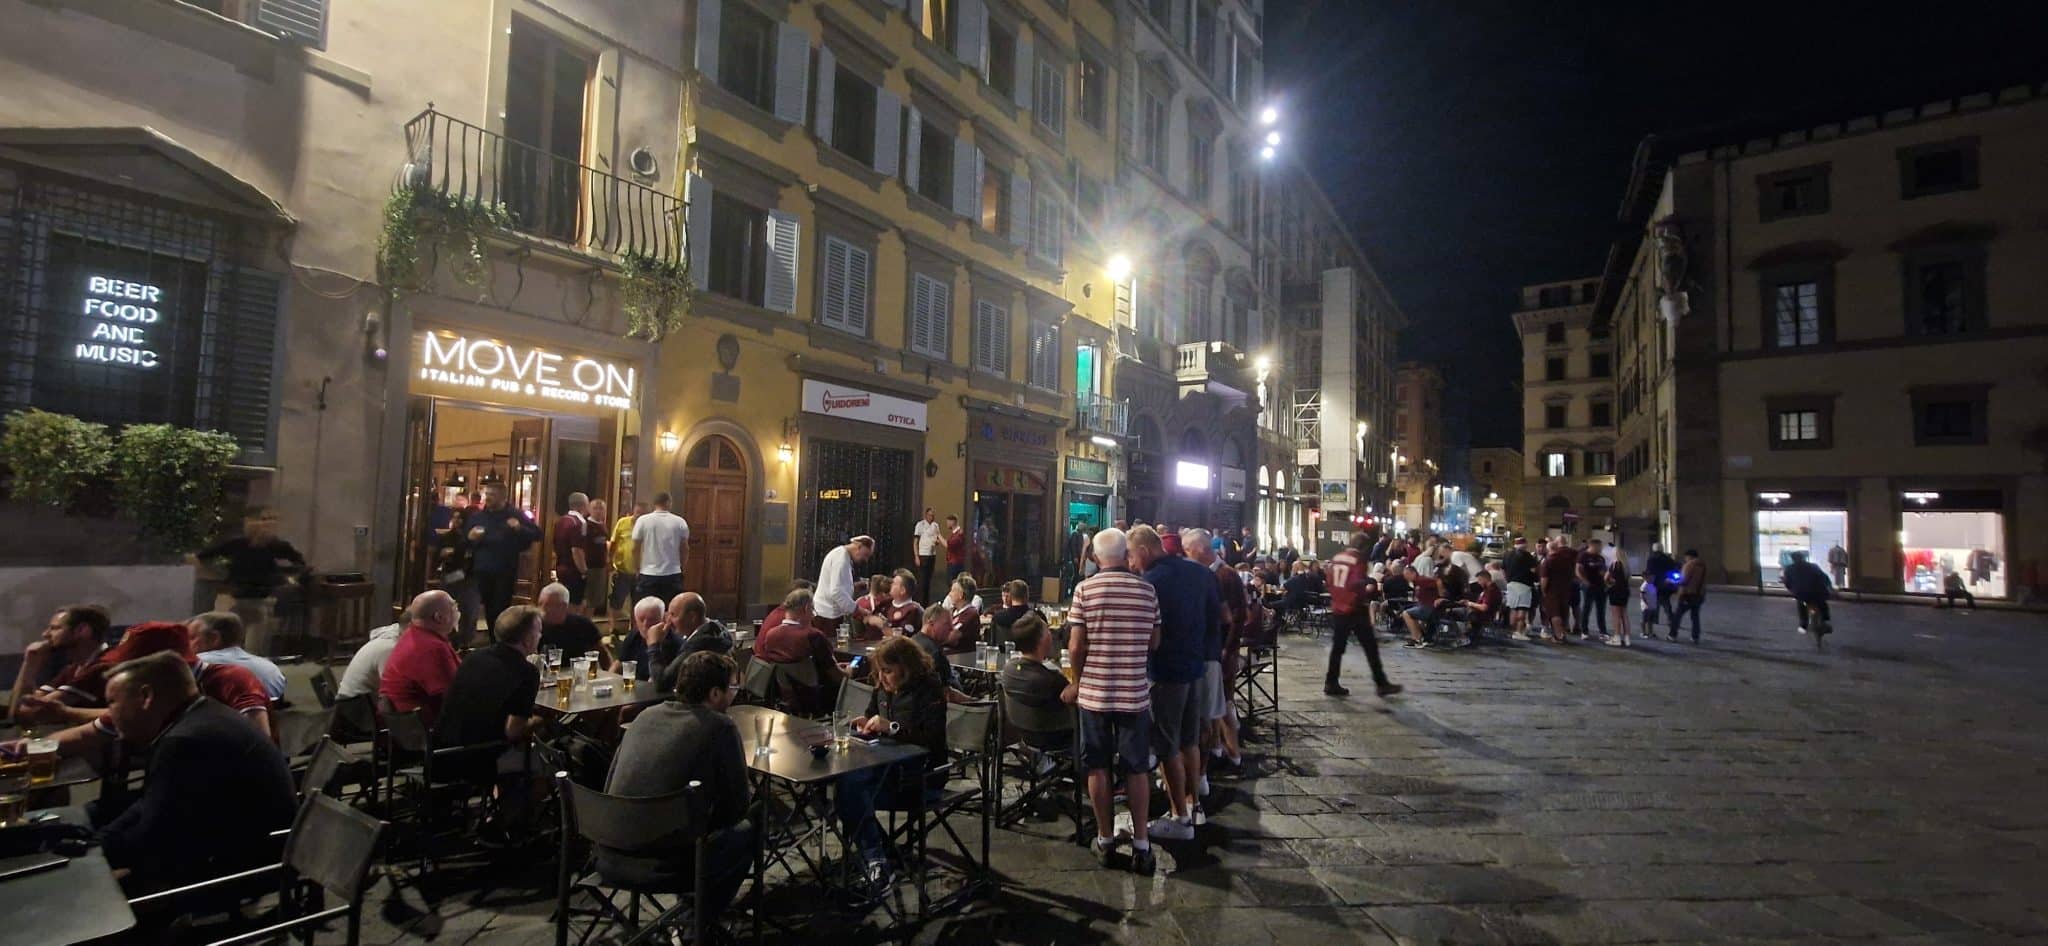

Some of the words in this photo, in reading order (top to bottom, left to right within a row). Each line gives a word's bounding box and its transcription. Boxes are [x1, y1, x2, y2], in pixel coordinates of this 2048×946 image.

[89, 276, 160, 302] BEER
[84, 299, 158, 323] FOOD
[92, 322, 145, 344] AND
[76, 343, 159, 368] MUSIC
[424, 331, 563, 386] MOVE
[573, 359, 635, 397] ON
[421, 367, 485, 388] ITALIAN
[491, 377, 520, 393] PUB
[525, 383, 536, 395] &
[541, 386, 589, 403] RECORD
[594, 393, 631, 409] STORE
[887, 414, 916, 426] OTTICA
[1333, 563, 1349, 588] 17
